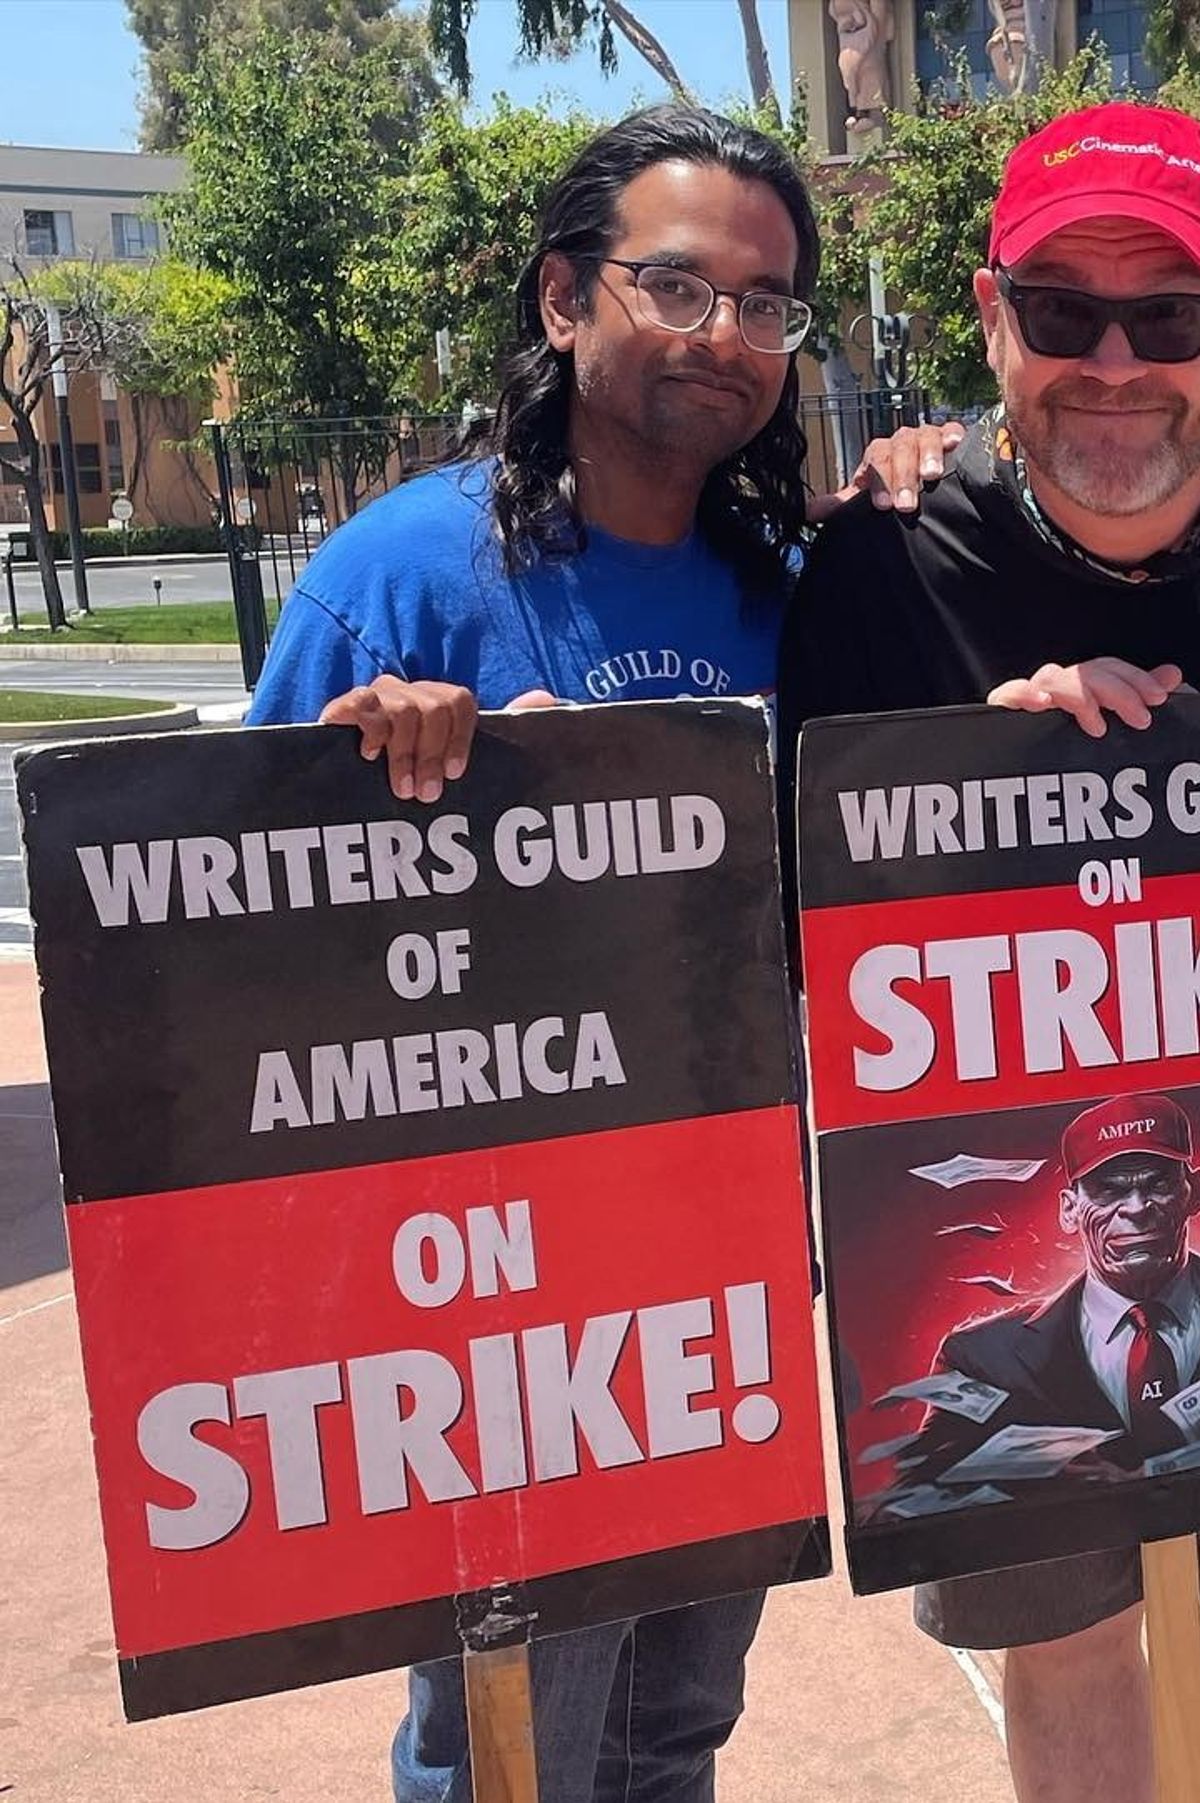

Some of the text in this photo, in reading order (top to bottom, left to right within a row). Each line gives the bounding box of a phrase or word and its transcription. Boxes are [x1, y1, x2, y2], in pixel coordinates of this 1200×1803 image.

[586, 649, 731, 700] GUILD OF
[838, 769, 1152, 861] WRITERS
[76, 796, 725, 928] WRITERS GUILD
[1078, 858, 1142, 906] ON
[386, 929, 470, 999] OF
[250, 1012, 626, 1132] AMERICA
[1098, 1118, 1156, 1141] AMPTP
[393, 1200, 536, 1307] ON
[138, 1282, 778, 1549] STRIKE!
[1140, 1380, 1163, 1400] AI
